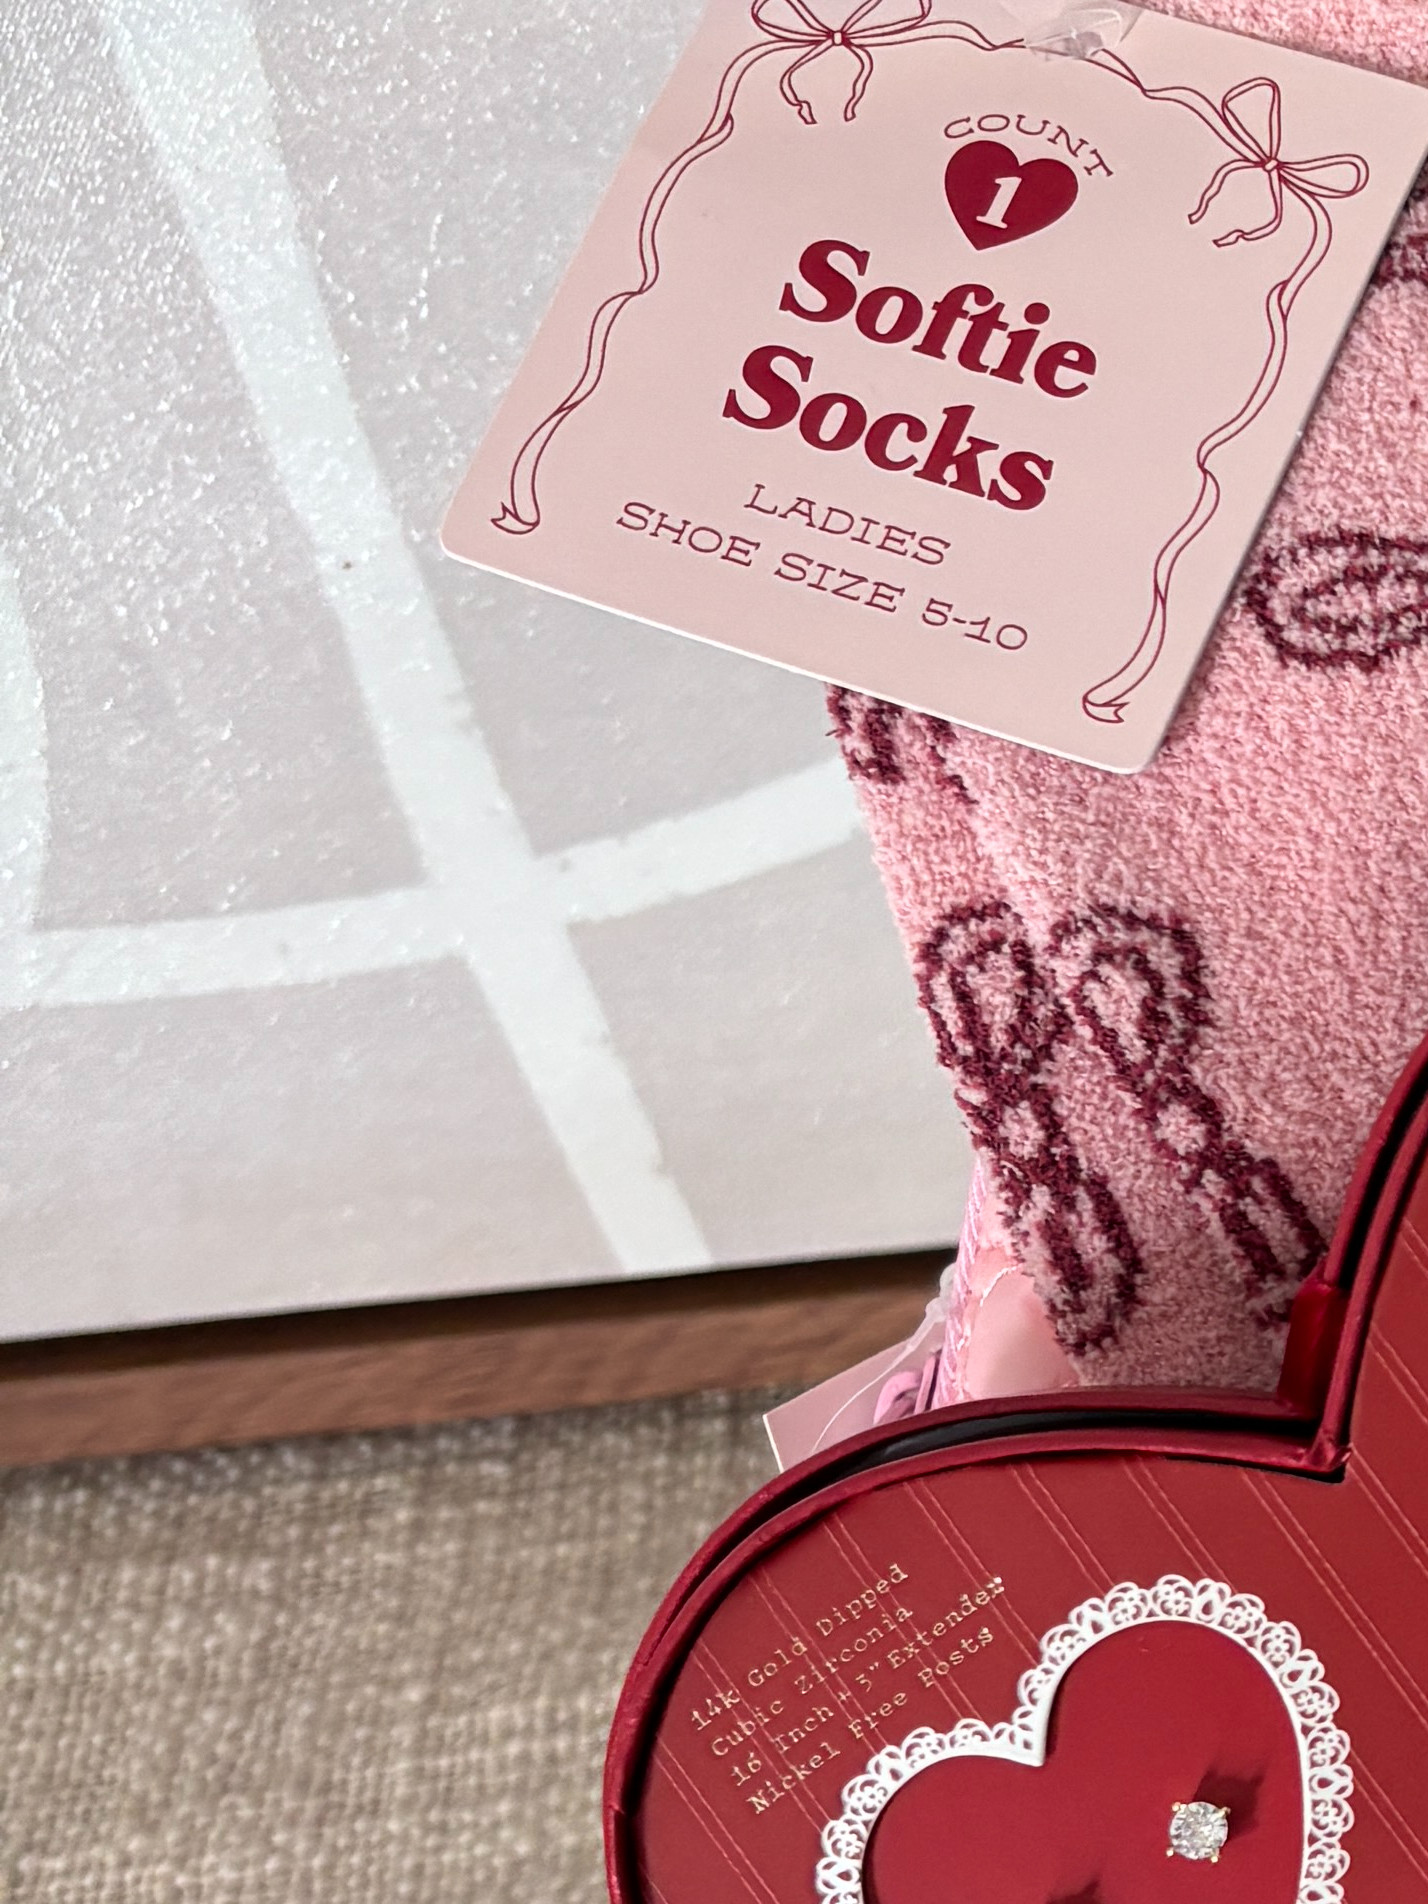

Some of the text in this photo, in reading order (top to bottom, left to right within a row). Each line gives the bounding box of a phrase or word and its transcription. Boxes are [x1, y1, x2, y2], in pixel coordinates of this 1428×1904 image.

[944, 113, 1113, 180] COUNT
[976, 176, 1021, 229] 1
[779, 239, 1098, 398] Softie
[721, 344, 1055, 511] Socks
[615, 501, 1029, 651] SHOE SIZE 5-10
[743, 483, 950, 567] LADIES
[712, 1607, 913, 1756] Cubic Zirconia
[747, 1637, 807, 1687] Gold
[816, 1563, 908, 1637] Dipped
[732, 1752, 762, 1786] 16
[772, 1705, 834, 1755] Inch
[746, 1627, 994, 1814] Nickel Free Posts
